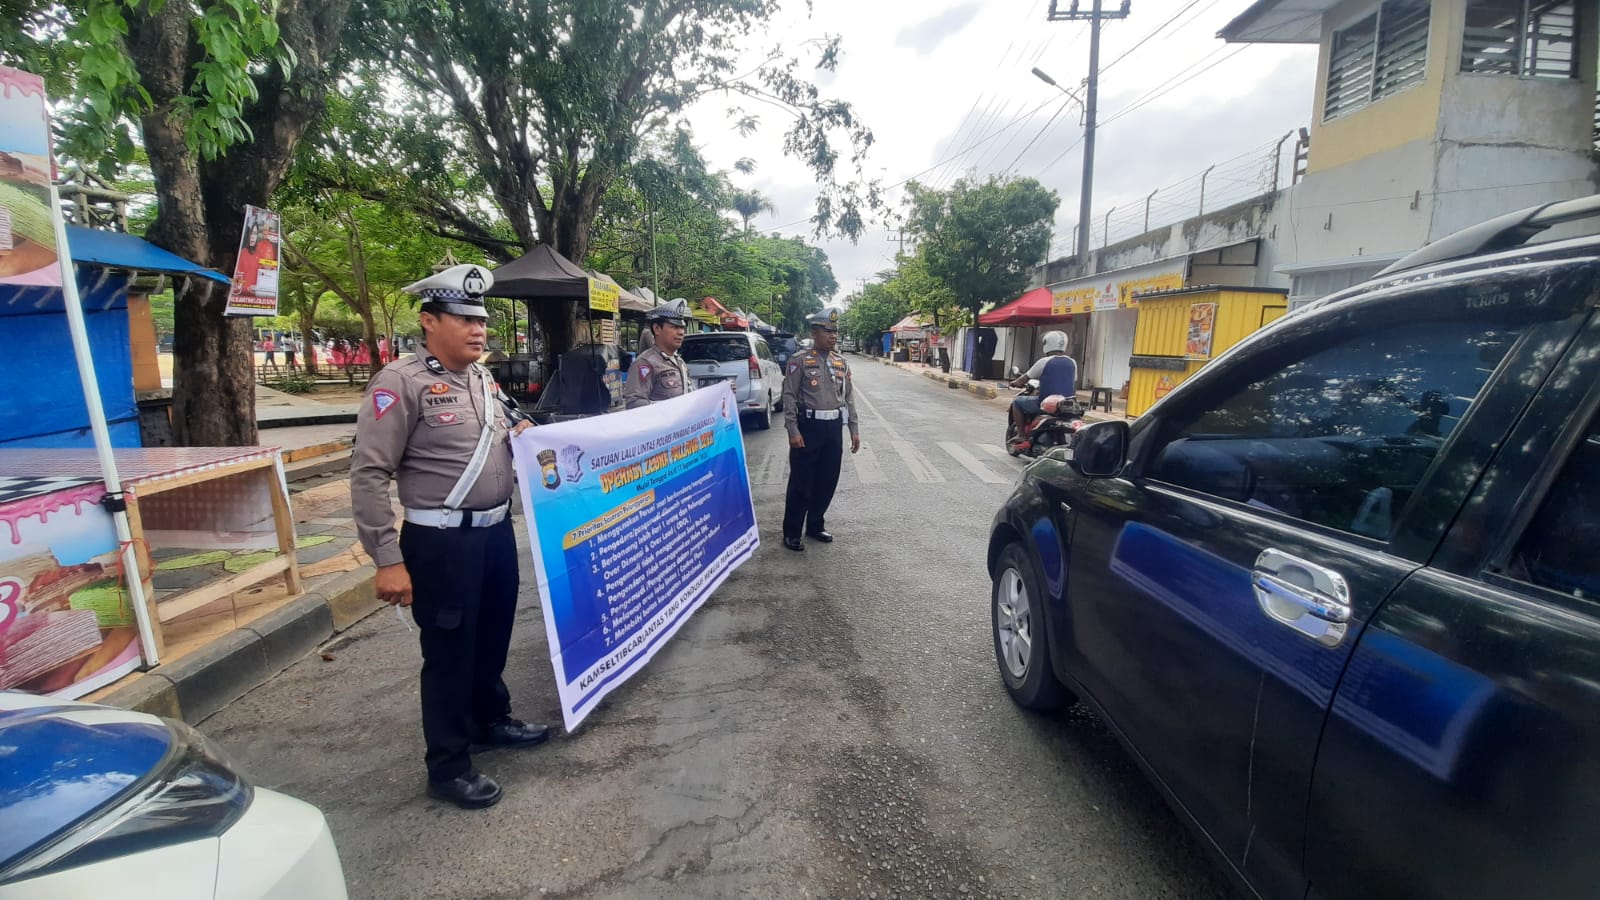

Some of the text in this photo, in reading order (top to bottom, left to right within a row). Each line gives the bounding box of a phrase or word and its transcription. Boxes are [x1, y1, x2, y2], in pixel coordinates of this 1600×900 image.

[1464, 292, 1510, 309] TERIOS
[426, 396, 458, 406] VENNY
[591, 452, 619, 469] SATUAN
[621, 448, 636, 458] LALU
[637, 442, 655, 453] LINTAS
[600, 463, 642, 493] OPERASI
[644, 452, 669, 474] ZEBRA
[636, 481, 649, 490] Mulai
[651, 473, 667, 483] Tanggal
[682, 458, 698, 468] September
[578, 522, 602, 537] Prioritas
[604, 512, 622, 523] Sasaran
[623, 497, 649, 512] Pelanggaran
[596, 516, 639, 543] Menggunakan
[639, 504, 654, 517] Ponsel
[656, 499, 666, 507] saat
[592, 564, 599, 573] 3.
[601, 542, 637, 567] Berbonceng
[638, 531, 651, 543] lebih
[651, 524, 661, 534] dari
[666, 515, 678, 524] orang
[596, 589, 604, 598] 4.
[606, 563, 640, 592] Pengemudi
[641, 554, 654, 567] tidak
[656, 532, 686, 556] menggunakan
[603, 567, 619, 580] Over
[621, 549, 643, 568] Dimensi
[649, 538, 661, 548] Over
[662, 527, 673, 539] Load
[601, 613, 608, 622] 5.
[610, 584, 645, 616] Pengemudi
[676, 552, 689, 564] dalam
[608, 575, 645, 604] Pengendara
[646, 562, 658, 575] tidak
[659, 540, 690, 565] menggunakan
[603, 626, 610, 635] 6.
[612, 603, 641, 628] Melawan
[642, 593, 653, 604] arus
[654, 584, 664, 593] lalu
[664, 574, 676, 585] lintas
[679, 560, 693, 572] Contra
[604, 637, 612, 647] 7.
[614, 612, 642, 640] Melebihi
[642, 602, 656, 616] batas
[657, 580, 680, 603] kecepatan
[664, 601, 678, 619] YANG
